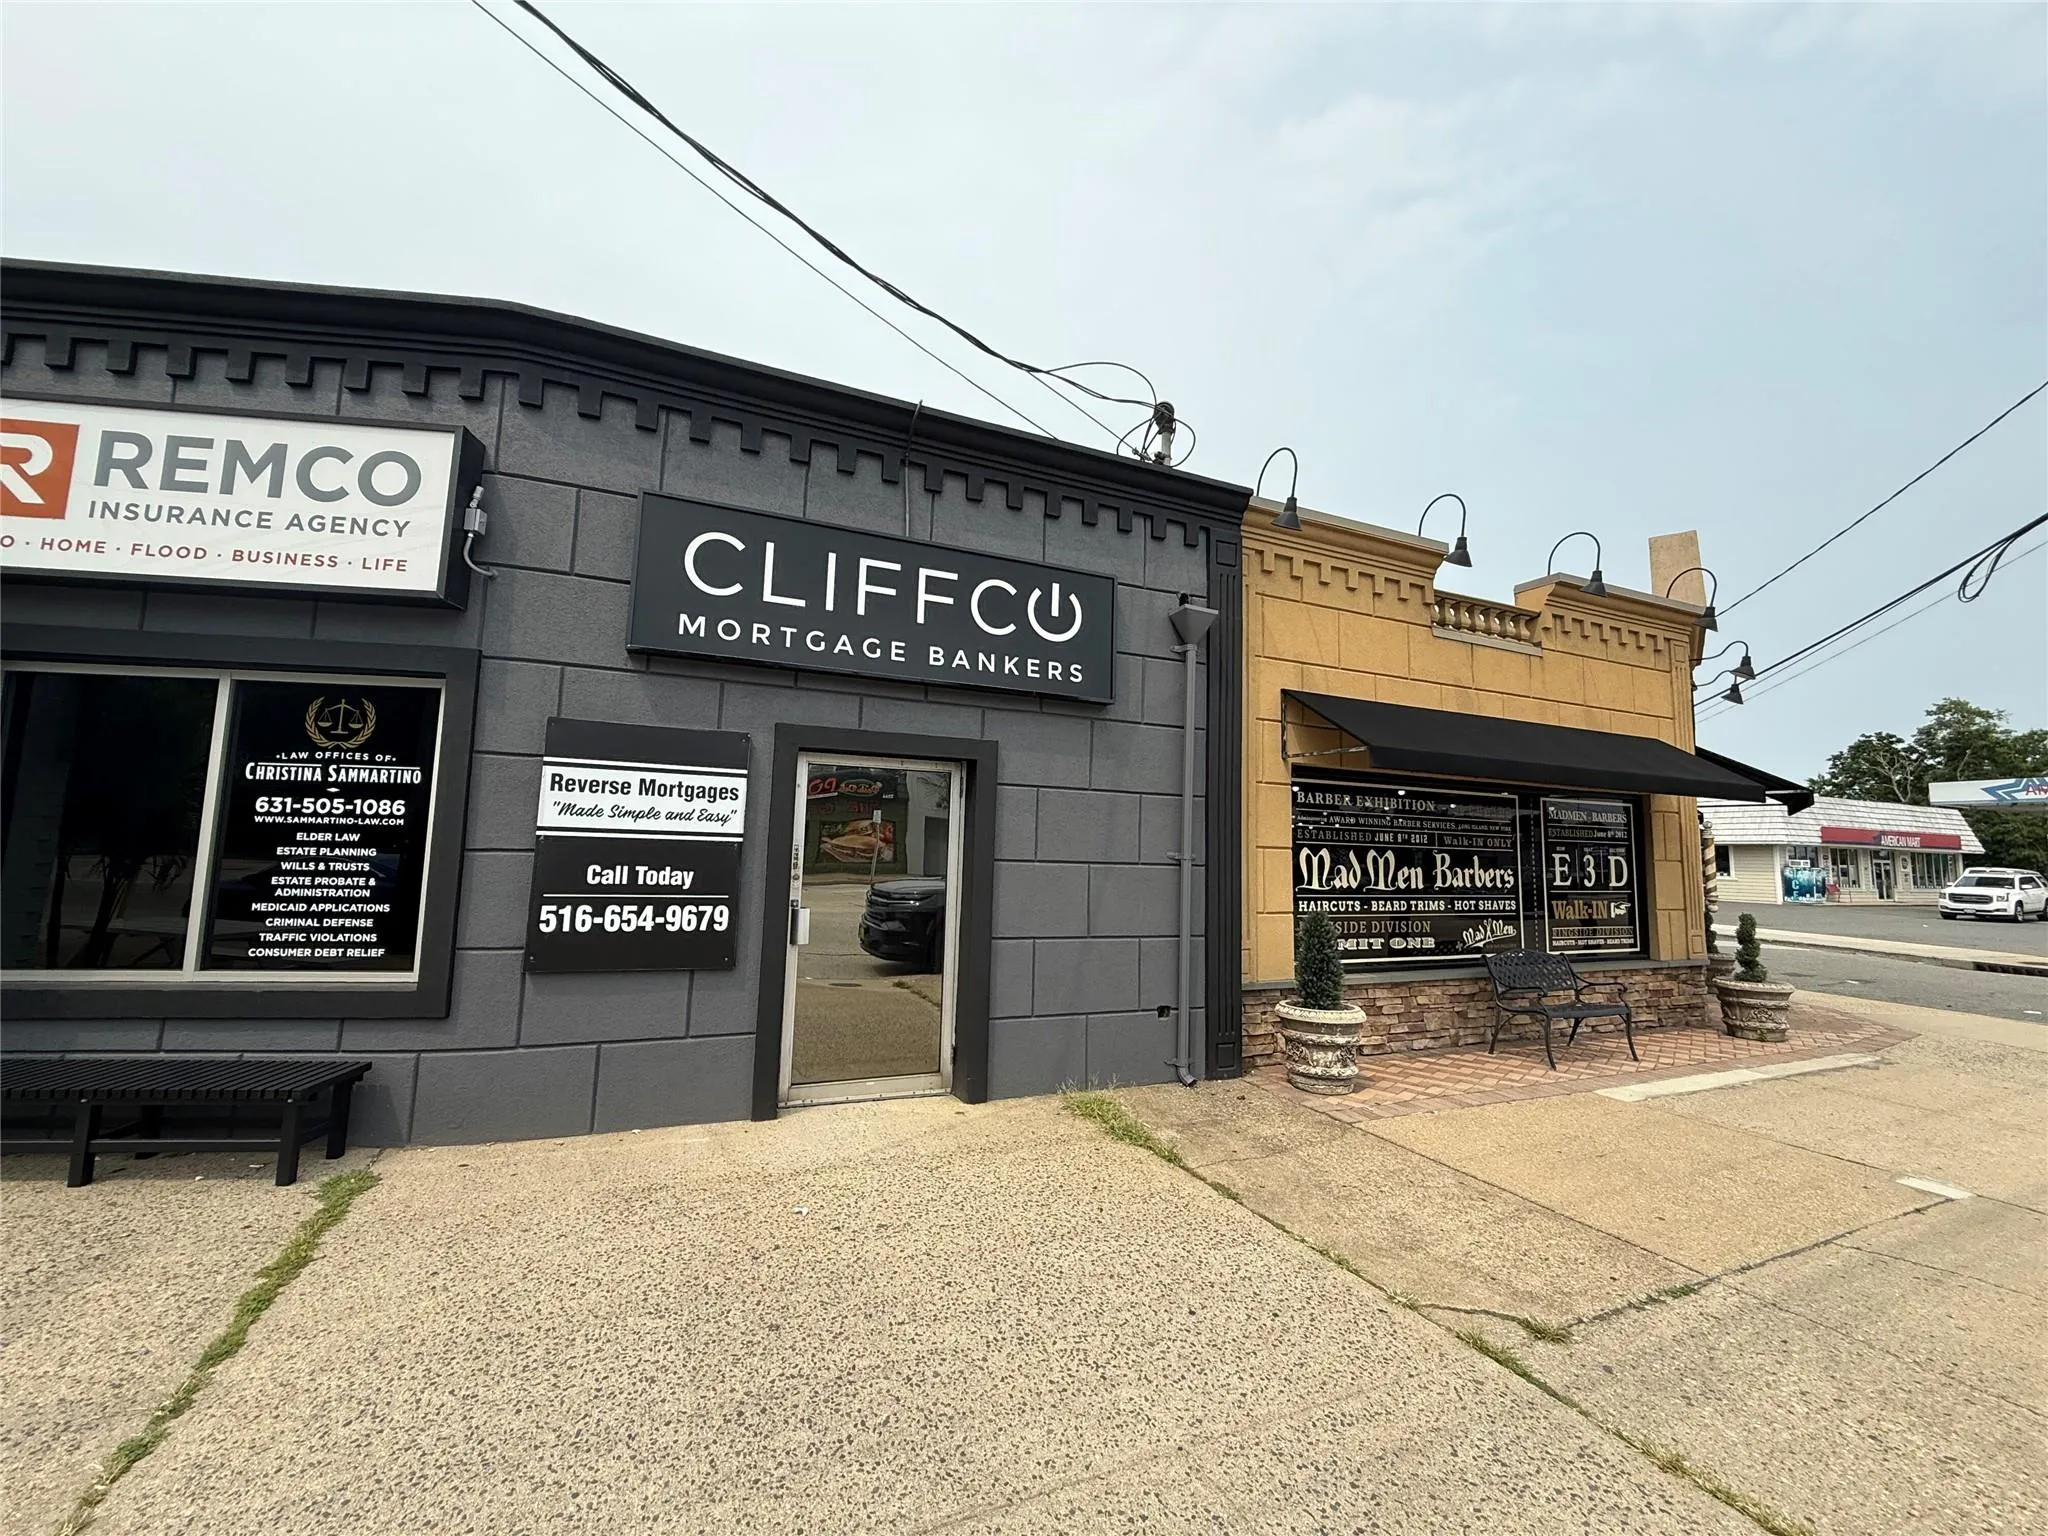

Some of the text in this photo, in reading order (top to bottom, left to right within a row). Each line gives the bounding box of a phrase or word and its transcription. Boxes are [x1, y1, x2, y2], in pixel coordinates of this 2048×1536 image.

[94, 430, 422, 507] REMCO
[89, 500, 410, 538] INSURANCE AGENCY
[41, 537, 106, 554] HOME
[130, 543, 207, 560] FLOOD
[232, 549, 338, 568] BUSINESS
[362, 557, 408, 572] LIFE
[684, 532, 1082, 642] CLIFFCO
[678, 614, 1083, 683] MORTGAGE BANKERS
[282, 752, 308, 760] LAW
[315, 752, 369, 761] OFFICES
[245, 762, 422, 784] CHRISTINA SAMMARTINO
[550, 773, 739, 803] Reverse Mortgages
[255, 796, 406, 815] 631-505-1086
[1297, 791, 1435, 811] BARBER EXHIBITION
[553, 802, 737, 826] "Made Simple and Easy"
[1592, 812, 1627, 823] BARBERS
[254, 816, 404, 826] WWW.SAMMARTINO-LAW.COM
[1329, 816, 1356, 824] AWARD
[1358, 817, 1391, 826] WINNING
[1394, 819, 1420, 828] BARBER
[296, 832, 360, 841] ELDER LAW
[1297, 829, 1372, 840] ESTABLISHED
[1375, 833, 1394, 842] JUNE
[1411, 834, 1428, 844] 2012
[1548, 828, 1593, 838] ESTABLISHED
[1444, 836, 1512, 847] Walk-IN ONLY
[1881, 835, 1920, 847] AMERICAN MART
[277, 847, 377, 857] ESTATE PLANNING
[280, 862, 369, 871] WILLS & TRUSTS
[1296, 847, 1514, 893] Mad Men Barbers
[1552, 854, 1572, 886] E
[1583, 855, 1596, 887] 3
[1608, 856, 1628, 887] D
[271, 877, 376, 886] ESTATE PROBATE &
[586, 864, 694, 889] Call Today
[275, 888, 370, 897] ADMINISTRATION
[251, 903, 390, 912] MEDICAID APPLICATIONS
[1298, 901, 1360, 912] HAIRCUTS
[1371, 901, 1407, 912] BEARD
[1410, 901, 1445, 911] TRIMS
[1454, 901, 1476, 910] HOT
[1478, 900, 1516, 910] SHAVES
[1552, 900, 1608, 920] Walk-IN
[265, 918, 373, 927] CRIMINAL DEFENSE
[539, 904, 729, 932] 516-654-9679
[1371, 921, 1431, 933] DIVISION
[259, 933, 377, 942] TRAFFIC VIOLATIONS
[1390, 937, 1435, 949] ONE
[248, 948, 385, 957] CONSUMER DEBT RELIEF
